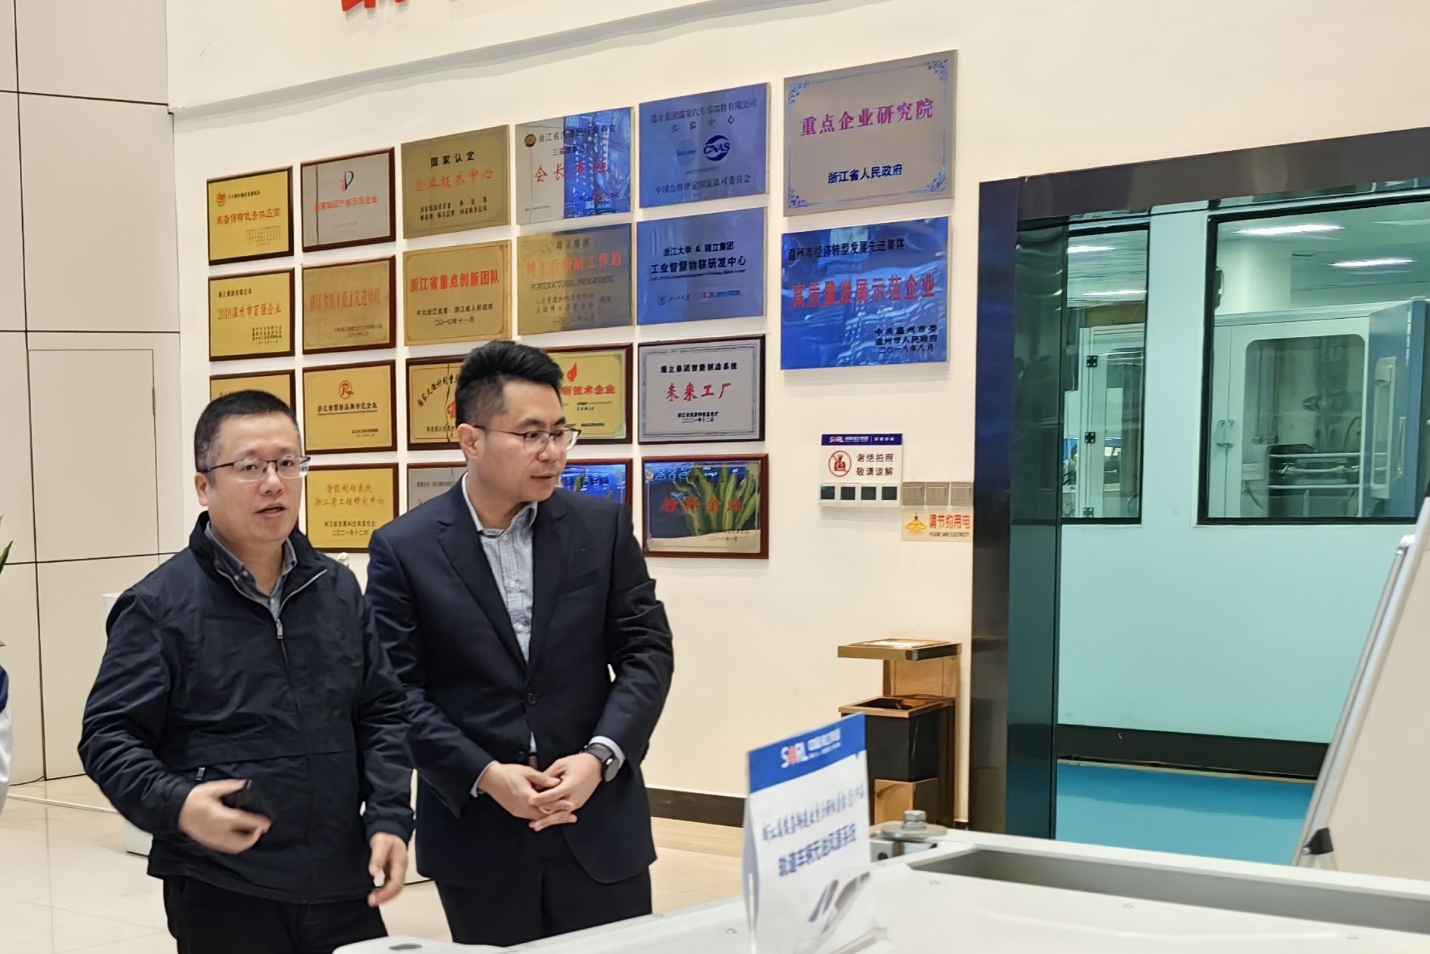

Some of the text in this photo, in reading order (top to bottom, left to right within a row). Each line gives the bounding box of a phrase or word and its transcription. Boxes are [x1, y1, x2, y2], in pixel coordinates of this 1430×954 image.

[800, 98, 934, 136] 重点企业研究院
[703, 142, 730, 155] CNAS
[430, 151, 475, 167] 国家认定
[828, 164, 903, 184] 浙江省人民政府
[663, 246, 691, 256] 浙江大学
[650, 256, 746, 274] 工业智慧物联研发中心
[410, 269, 500, 293] 浙江省重点创新团队
[792, 272, 935, 309] 高质量发展示范企业
[875, 325, 938, 336] 中共温州市委
[875, 335, 938, 346] 温州市人民政府
[665, 381, 732, 401] 未来工厂
[857, 453, 893, 462] 谢绝拍照
[856, 467, 893, 476] 敬请谅解
[929, 514, 970, 529] 请节约用电
